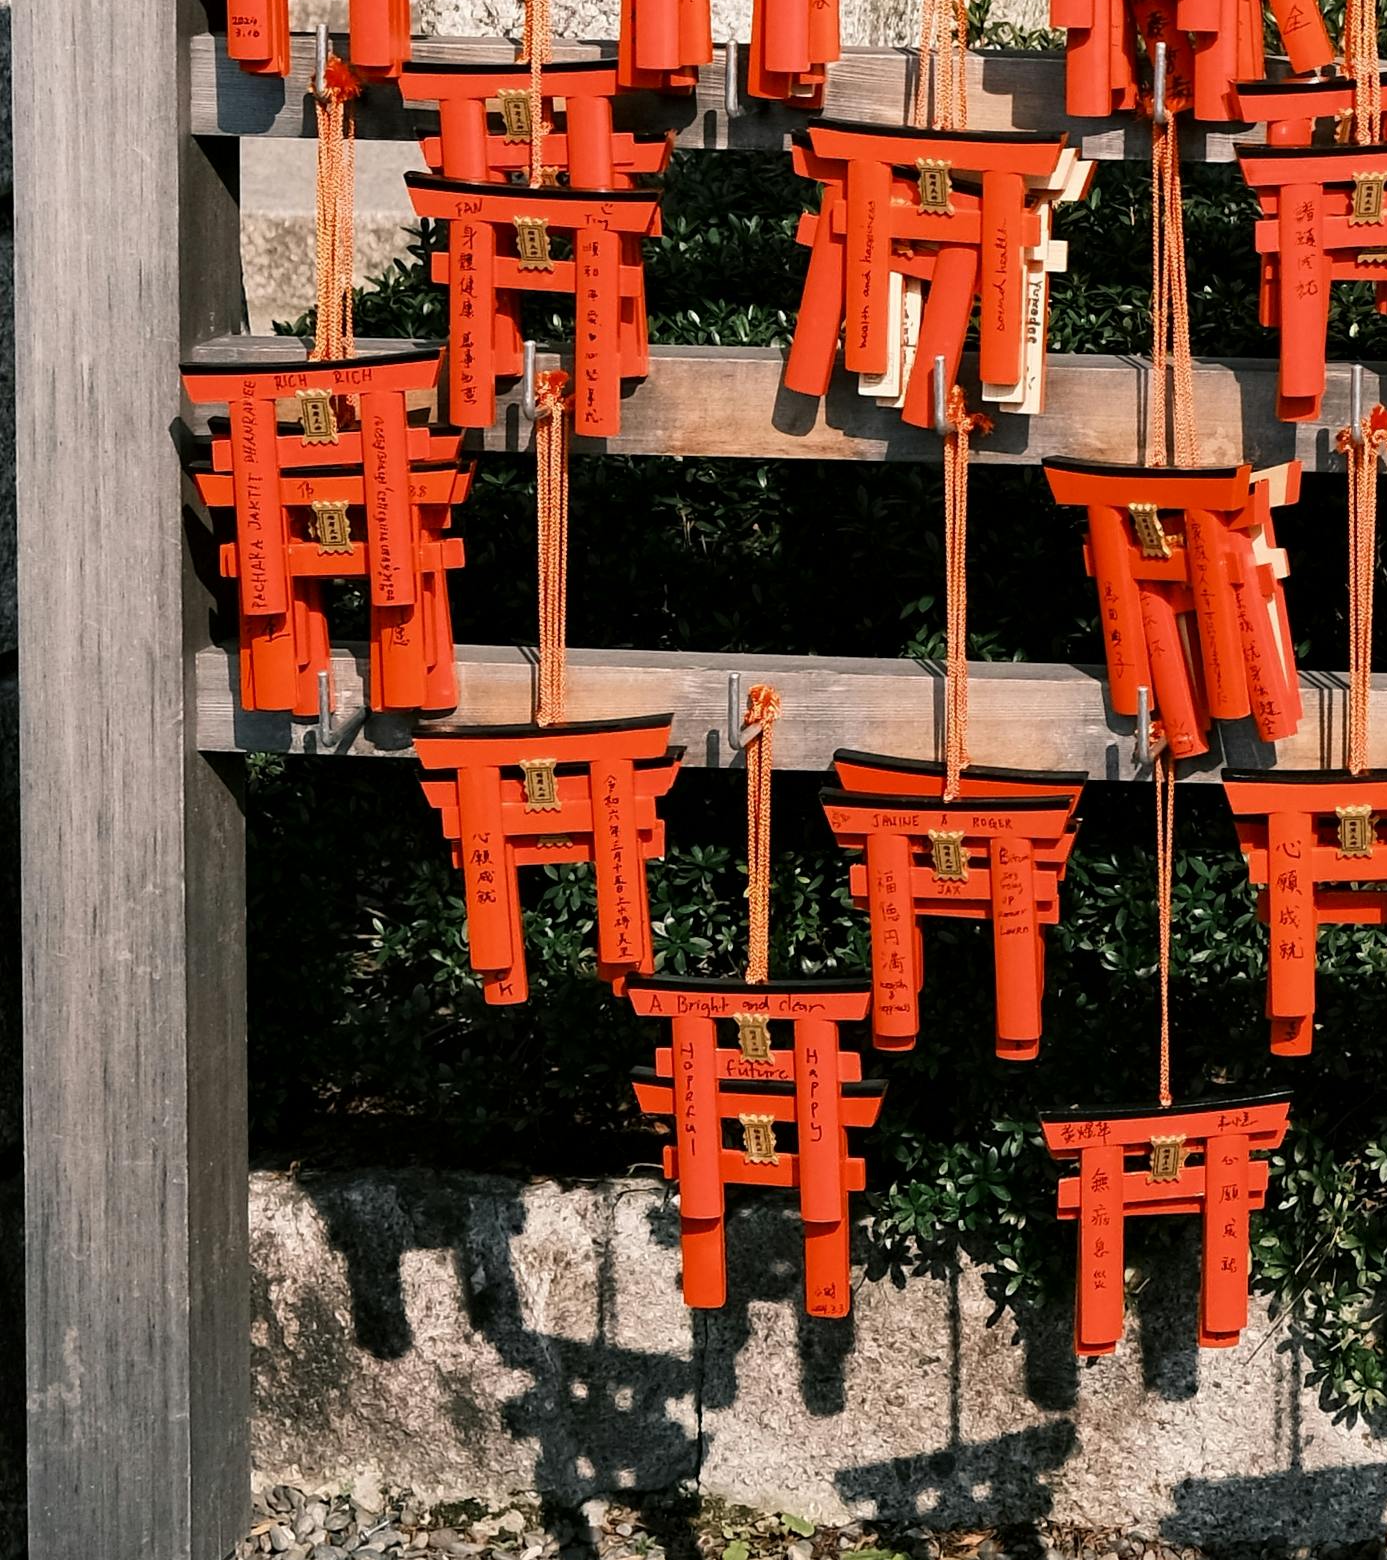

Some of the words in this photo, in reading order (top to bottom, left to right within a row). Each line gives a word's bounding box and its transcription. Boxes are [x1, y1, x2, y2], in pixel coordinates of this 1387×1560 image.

[273, 374, 308, 390] RICH
[332, 368, 373, 384] RICH
[872, 813, 920, 829] JANINE
[971, 816, 1014, 830] ROGER
[1275, 837, 1305, 962] 心願成就
[876, 868, 906, 975] 福徳円満
[649, 993, 664, 1014] A
[677, 992, 730, 1018] Bright
[742, 997, 769, 1014] and
[725, 1057, 790, 1082] future
